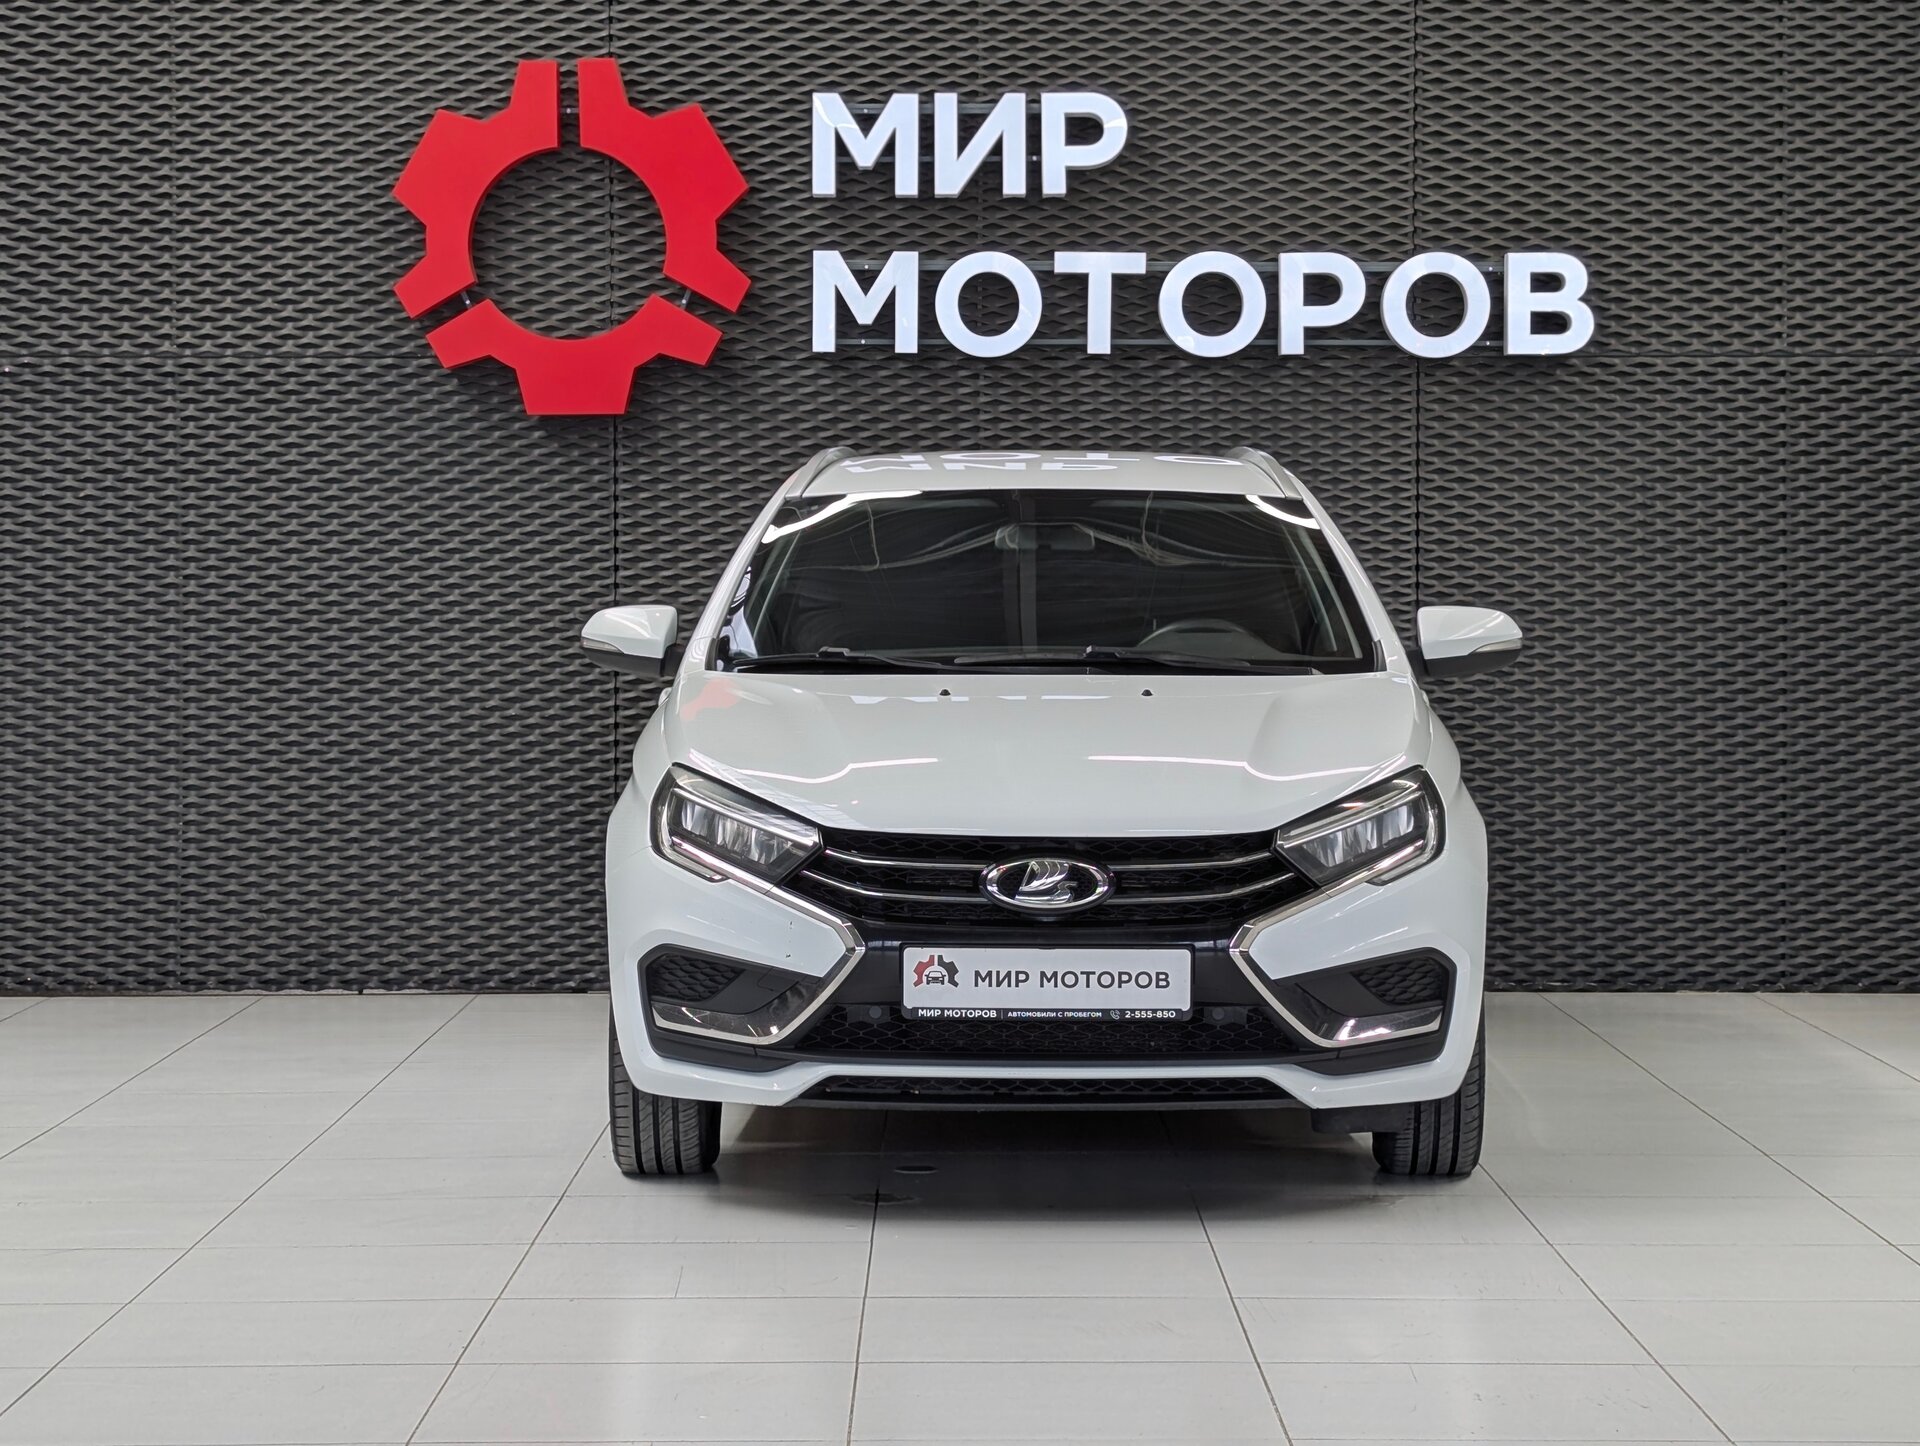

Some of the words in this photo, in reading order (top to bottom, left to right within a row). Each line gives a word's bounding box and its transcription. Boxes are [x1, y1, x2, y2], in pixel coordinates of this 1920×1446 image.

[812, 91, 1128, 198] МИР
[812, 250, 1596, 358] МОТОРОВ
[974, 970, 1030, 988] МИР
[1039, 970, 1171, 989] МОТОРОВ
[918, 1008, 942, 1018] МИР
[944, 1009, 998, 1018] МОТОРОВ
[1124, 1010, 1176, 1018] 2-555-850
